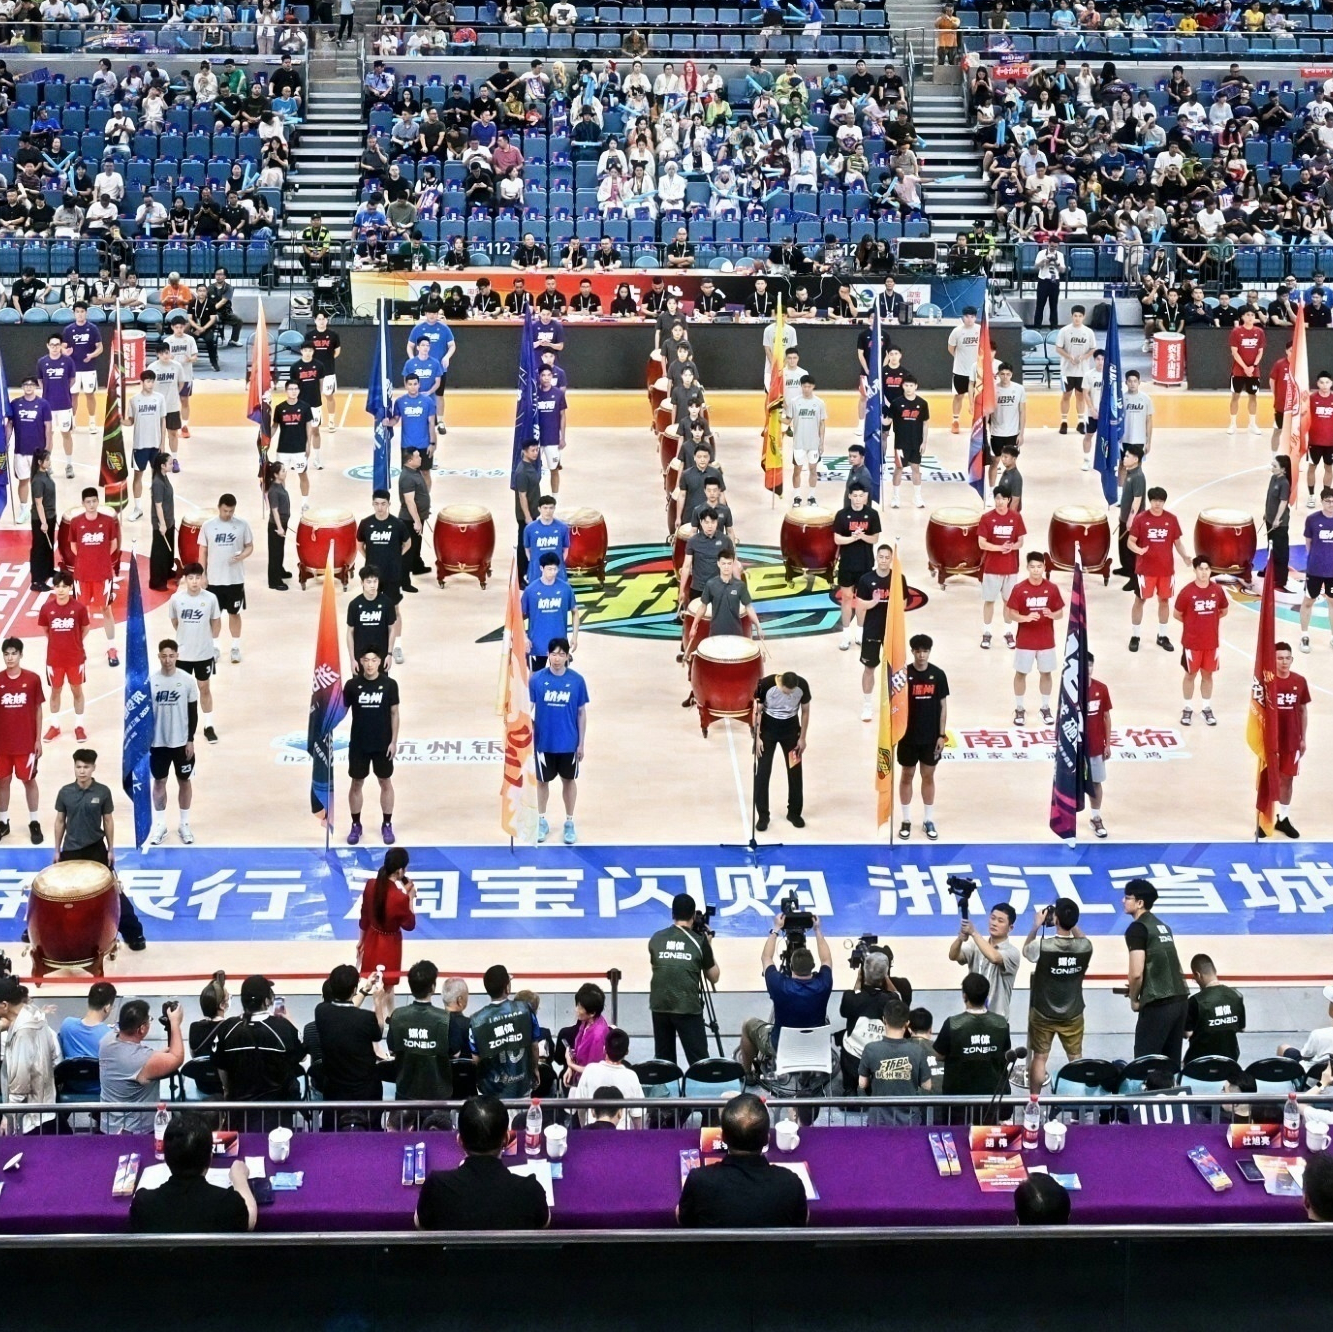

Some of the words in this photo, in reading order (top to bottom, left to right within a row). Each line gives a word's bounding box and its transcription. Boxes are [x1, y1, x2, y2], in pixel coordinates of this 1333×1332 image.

[486, 242, 511, 255] 112
[841, 242, 858, 256] 12
[214, 533, 237, 543] 桐乡
[370, 530, 392, 541] 台州
[536, 536, 558, 548] 杭州
[537, 597, 562, 609] 杭州
[180, 609, 204, 620] 桐乡
[359, 610, 382, 622] 台州
[155, 690, 182, 702] 桐乡
[357, 691, 384, 704] 台州
[543, 689, 571, 704] 杭州
[181, 764, 192, 774] 23
[343, 865, 835, 920] 淘宝闪购
[1058, 957, 1076, 967] 媒体
[408, 1027, 429, 1039] 媒体
[493, 1022, 515, 1038] 媒体
[970, 1034, 991, 1045] 媒体
[985, 1137, 1008, 1148] 胡伟
[1242, 1135, 1271, 1146] 杜旭亮
